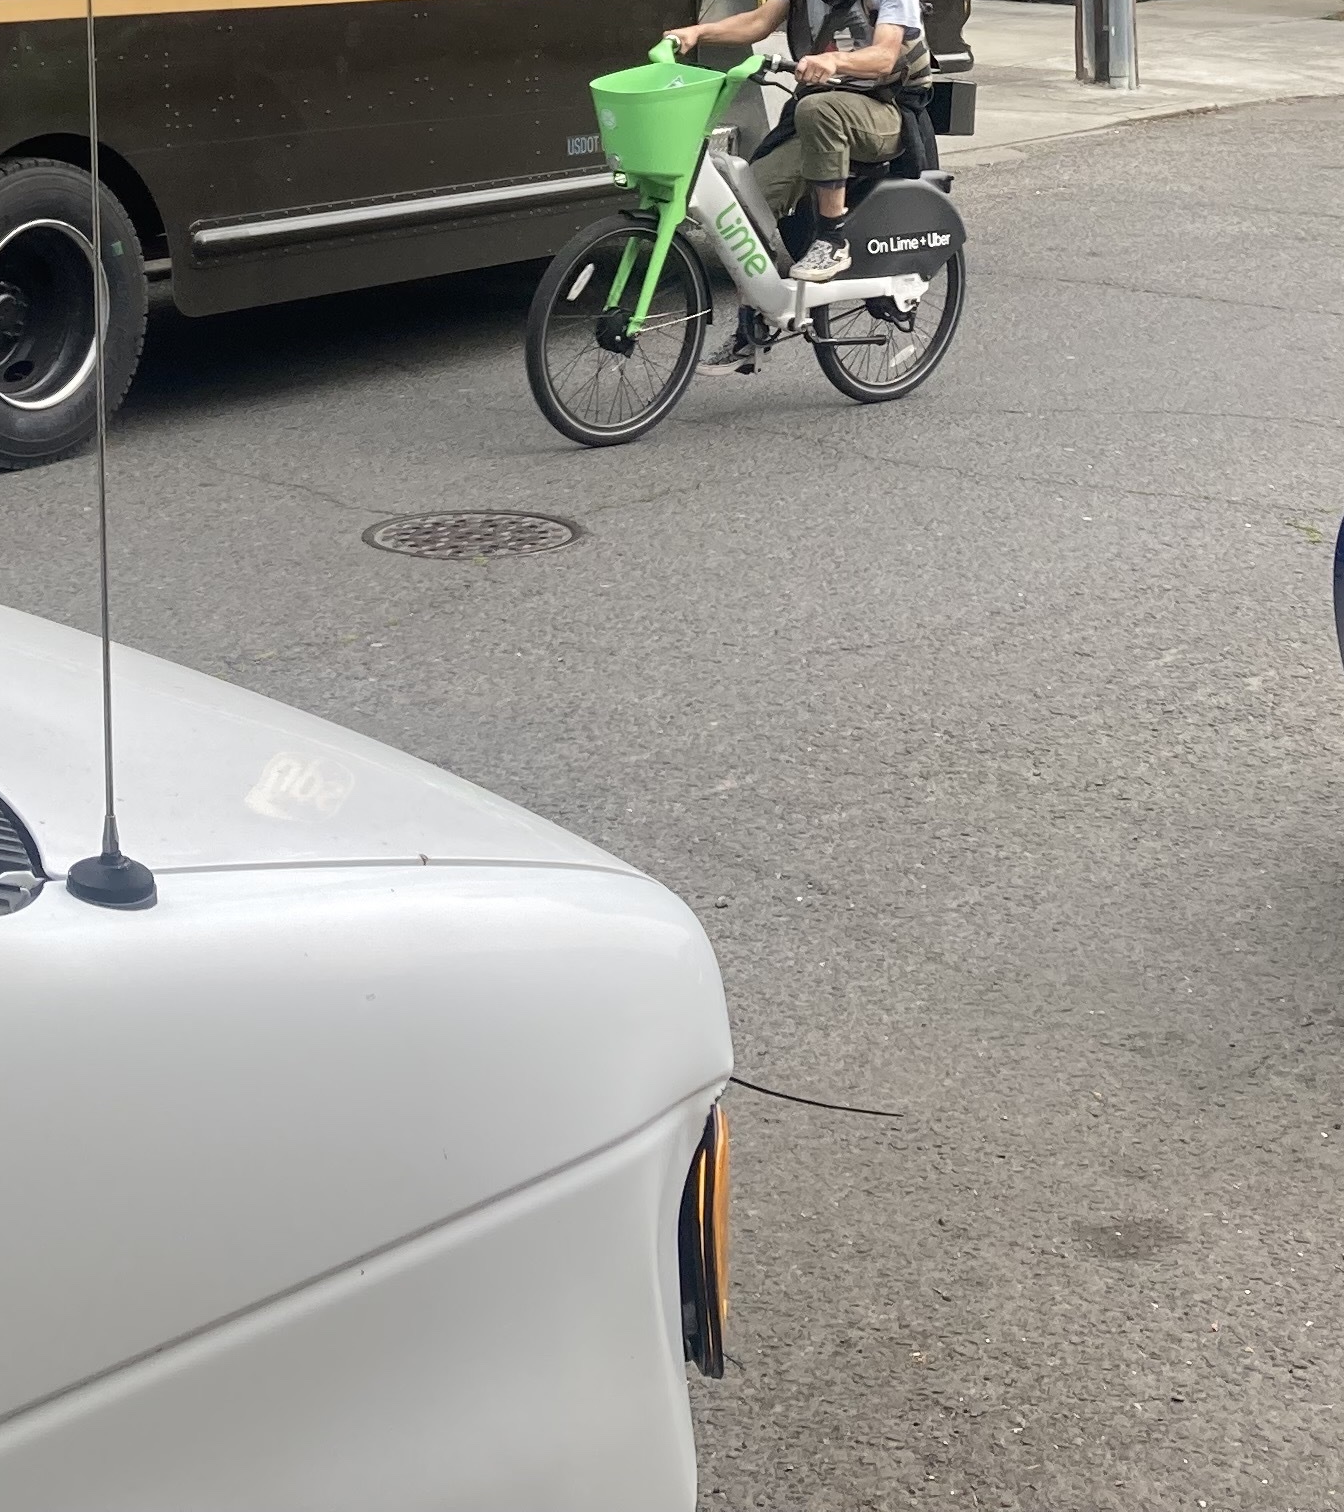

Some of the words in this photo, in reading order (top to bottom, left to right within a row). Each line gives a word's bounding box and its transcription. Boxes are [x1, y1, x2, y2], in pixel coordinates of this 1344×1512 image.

[567, 136, 599, 155] USDOT
[715, 201, 768, 278] Lime
[867, 238, 889, 254] On
[889, 236, 919, 252] Lime
[927, 232, 951, 248] Uber
